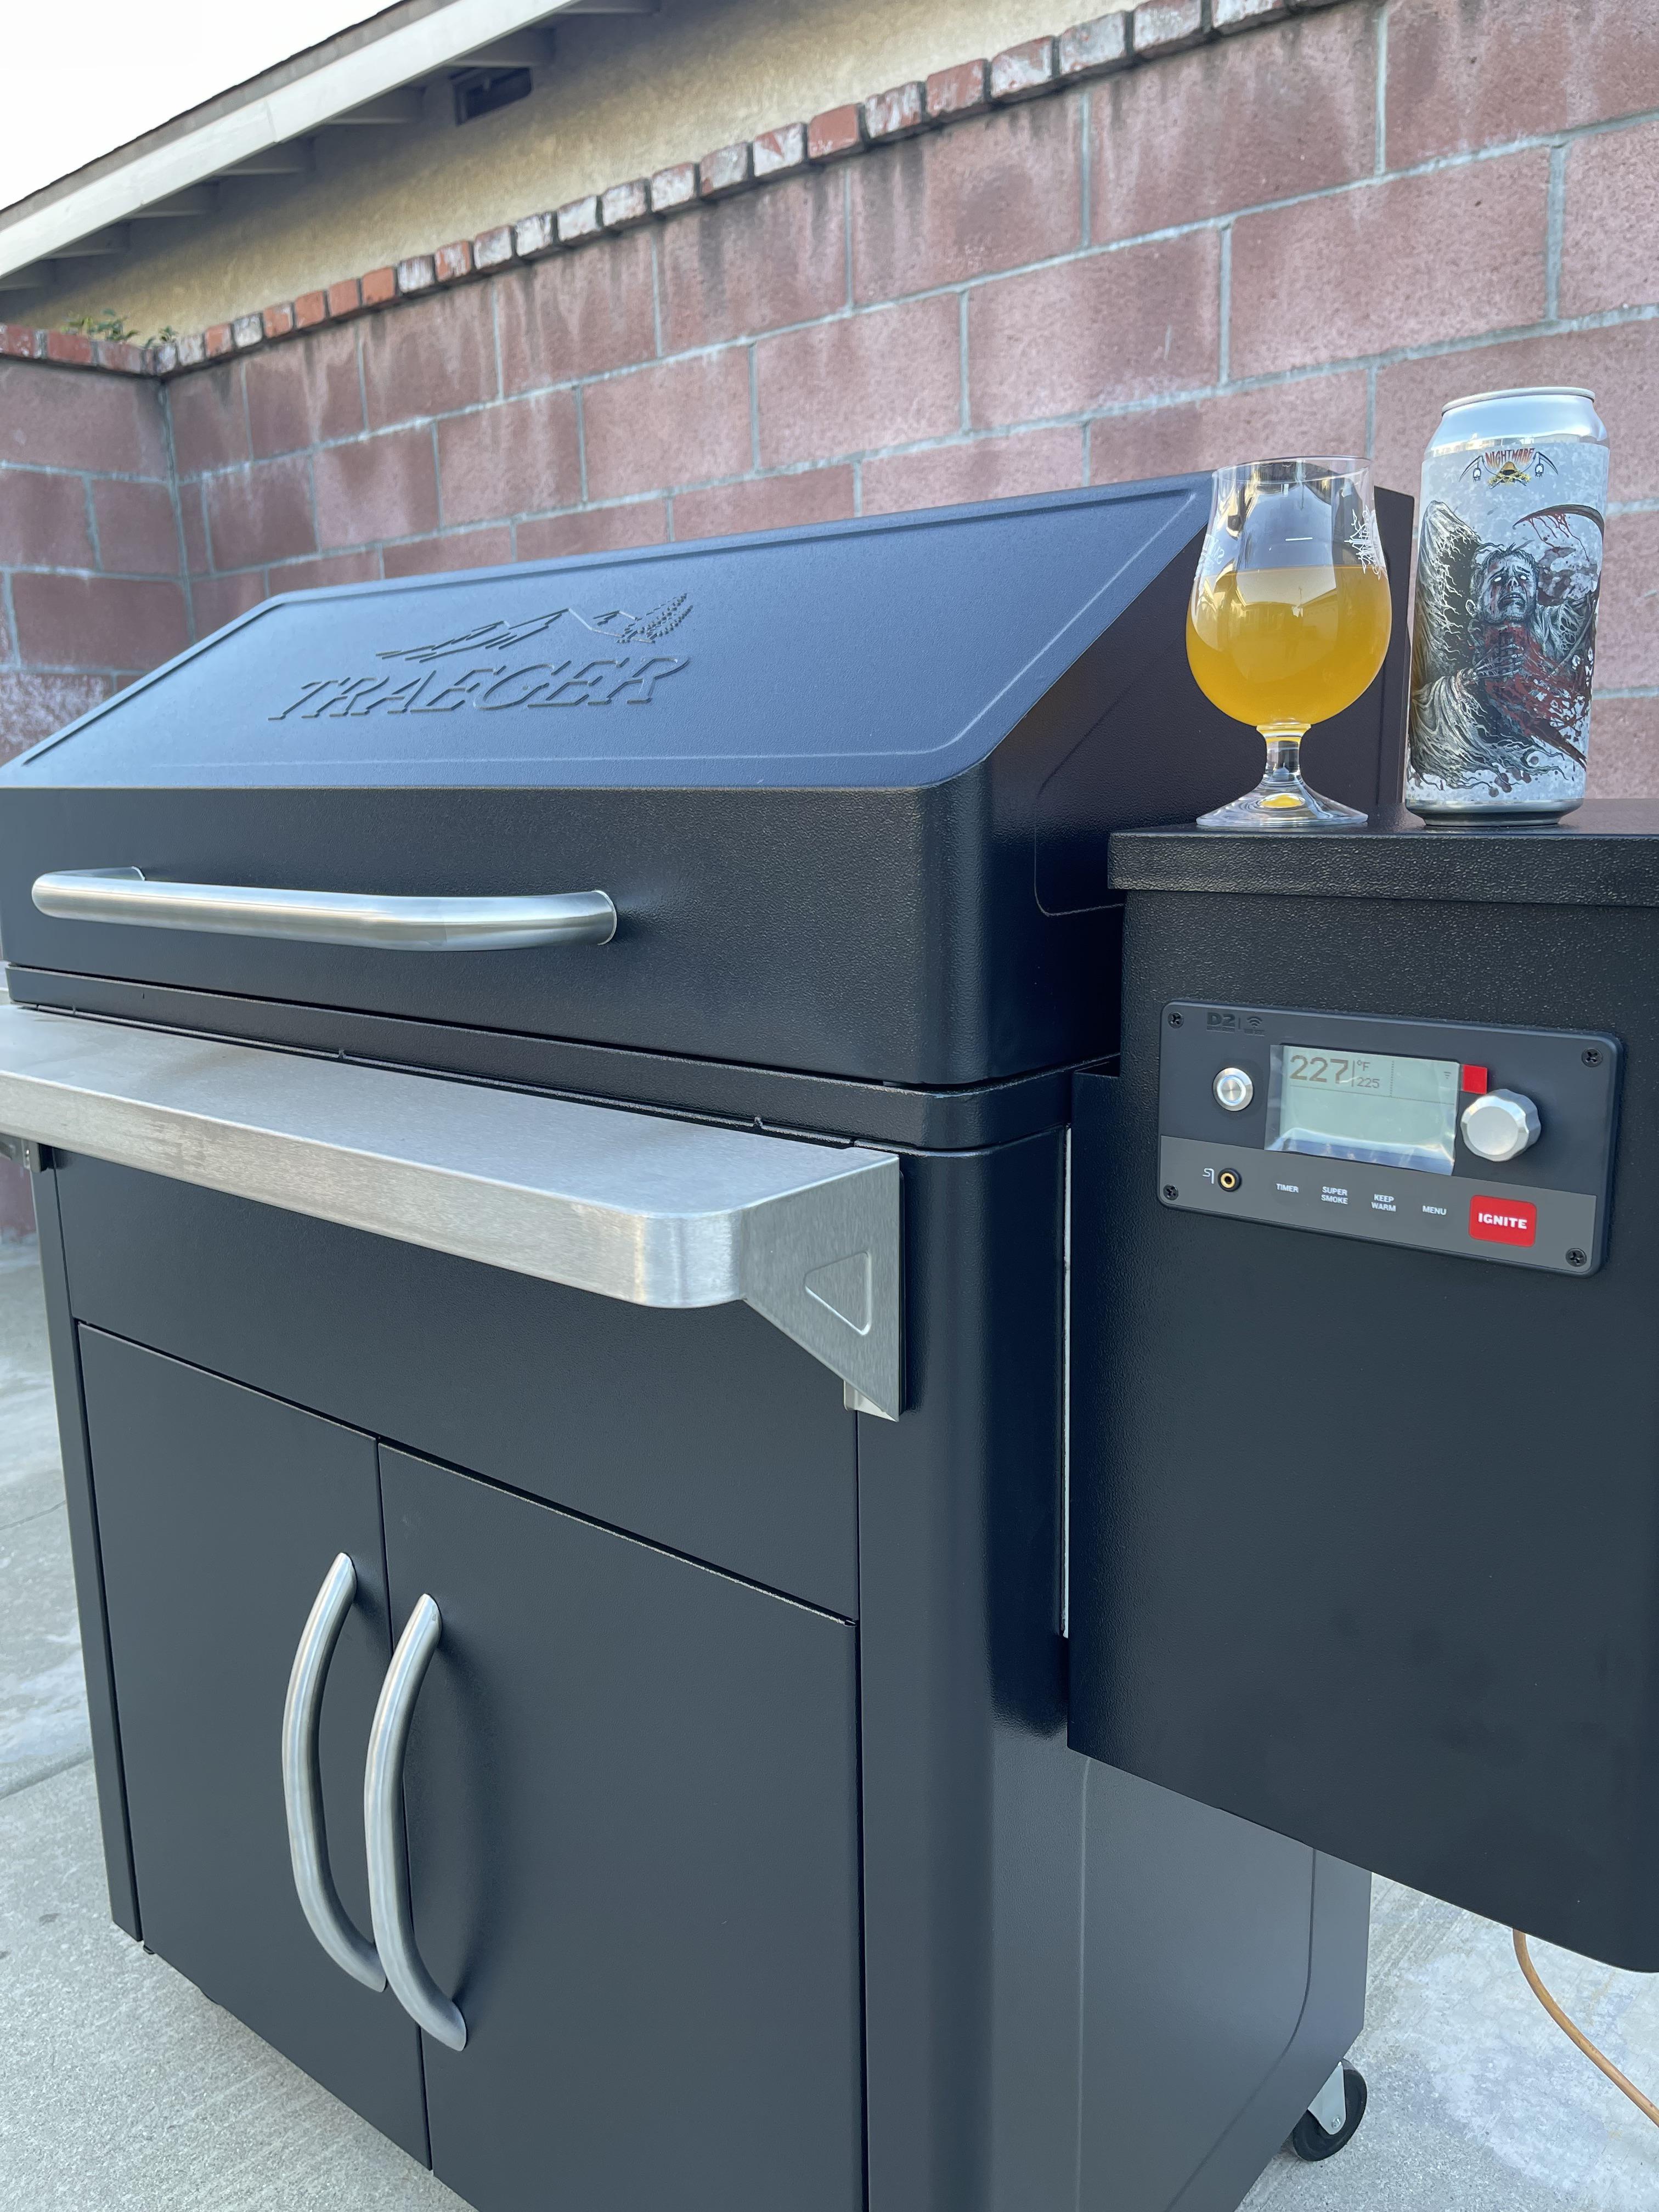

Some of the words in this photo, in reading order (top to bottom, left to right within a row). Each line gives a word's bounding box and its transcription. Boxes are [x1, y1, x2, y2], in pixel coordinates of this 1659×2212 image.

[268, 658, 690, 720] TRAEGER
[1207, 1012, 1235, 1028] D2
[1290, 1055, 1348, 1084] 227
[1356, 1077, 1380, 1088] 225
[1276, 1183, 1299, 1193] TIMER
[1322, 1186, 1347, 1195] SUPER
[1321, 1194, 1348, 1204] SMOKE
[1374, 1194, 1395, 1203] KEEP
[1371, 1202, 1396, 1212] WARM
[1423, 1206, 1447, 1215] MENU
[1478, 1212, 1527, 1229] IGNITE
